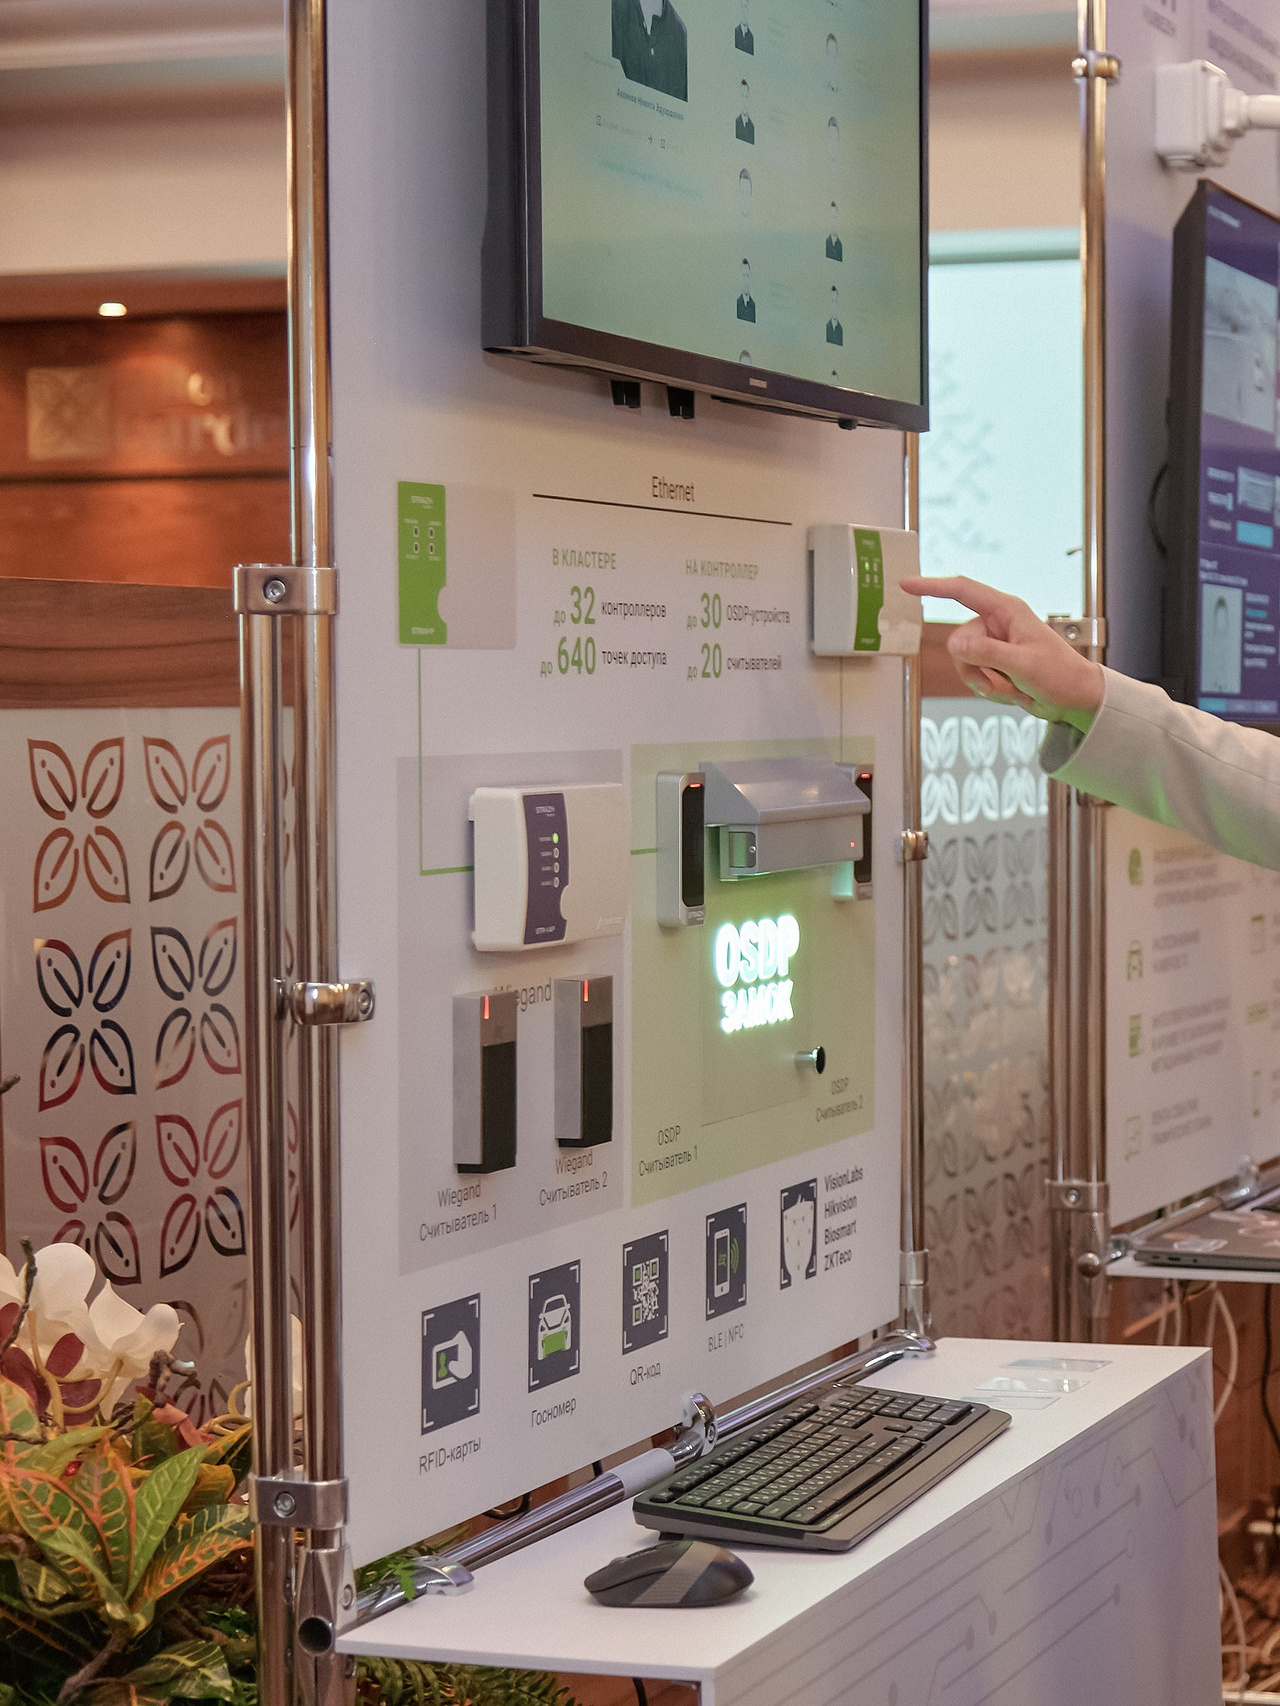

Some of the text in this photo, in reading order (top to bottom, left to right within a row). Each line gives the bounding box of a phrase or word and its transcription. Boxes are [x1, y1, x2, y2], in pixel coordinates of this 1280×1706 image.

[651, 475, 696, 502] Ethernet
[553, 548, 617, 570] В КЛАСТЕРЕ
[686, 559, 759, 580] НА КОНТРОЛЛЕР
[554, 585, 667, 627] до 32 контроллеров
[686, 592, 791, 631] до 30 OSDP-устройств
[540, 636, 668, 678] до 640 точек доступа
[686, 642, 783, 682] до 20 считывателей
[716, 915, 800, 986] OSDP
[721, 979, 794, 1033] ЗАМОК
[831, 1077, 850, 1095] OSDP
[816, 1098, 859, 1122] Считыватель
[658, 1125, 681, 1146] OSDP
[555, 1150, 594, 1175] Wiegand
[639, 1149, 692, 1177] Считыватель
[539, 1171, 608, 1206] Считыватель 2
[824, 1165, 864, 1193] VisionLabs
[437, 1179, 482, 1209] Wiegand
[824, 1194, 858, 1219] Hikvision
[419, 1204, 498, 1242] Считыватель 1
[824, 1220, 857, 1245] Biosmart
[824, 1248, 852, 1272] ZKTeco
[708, 1335, 723, 1353] BLE
[728, 1323, 745, 1346] NFC
[629, 1362, 662, 1386] QR-код
[531, 1397, 577, 1428] Госномер
[418, 1437, 482, 1475] RFID-карты
